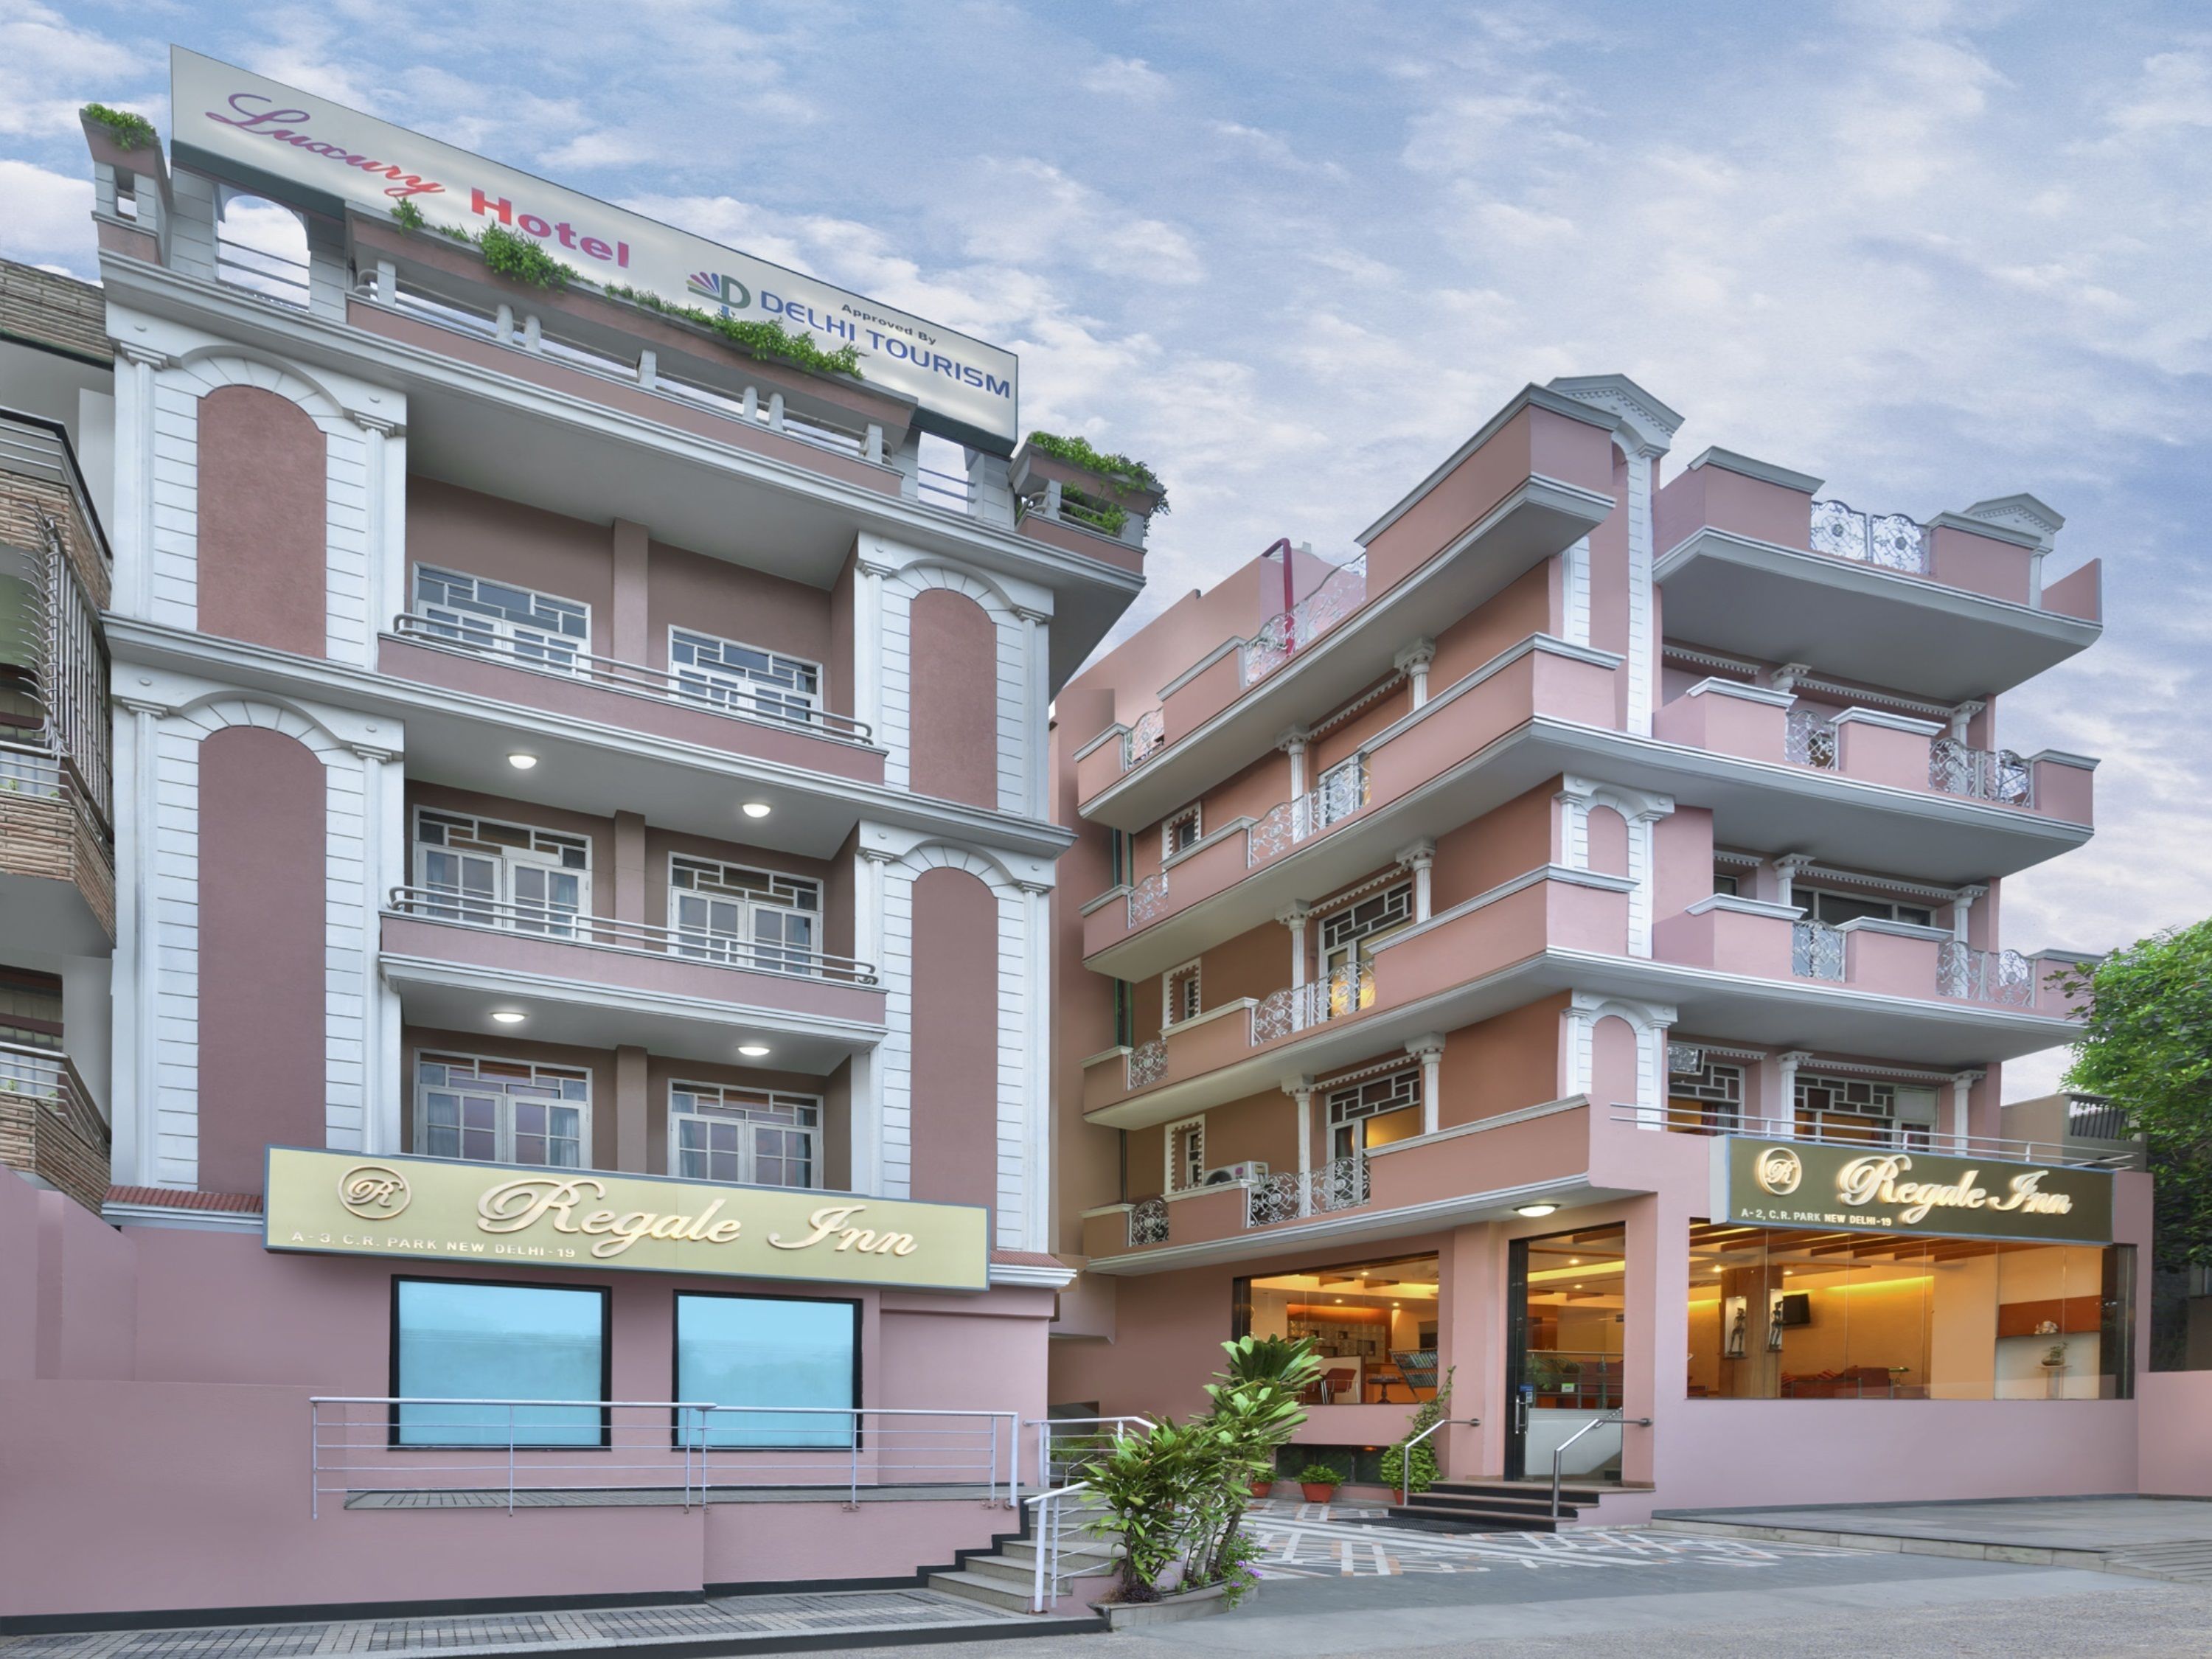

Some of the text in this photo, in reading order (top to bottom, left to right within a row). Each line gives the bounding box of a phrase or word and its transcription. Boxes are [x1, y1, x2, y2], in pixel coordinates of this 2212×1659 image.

[205, 93, 629, 268] Luxury Hotel
[761, 291, 1009, 398] DELHI TOURISM
[841, 303, 936, 346] Approved By
[476, 1178, 918, 1259] Regale Inn
[1794, 1212, 1821, 1222] PARK
[1824, 1214, 1846, 1223] NEW
[1838, 1154, 2073, 1225] Regale Inn
[387, 1237, 437, 1251] PARK
[447, 1242, 485, 1253] NEW
